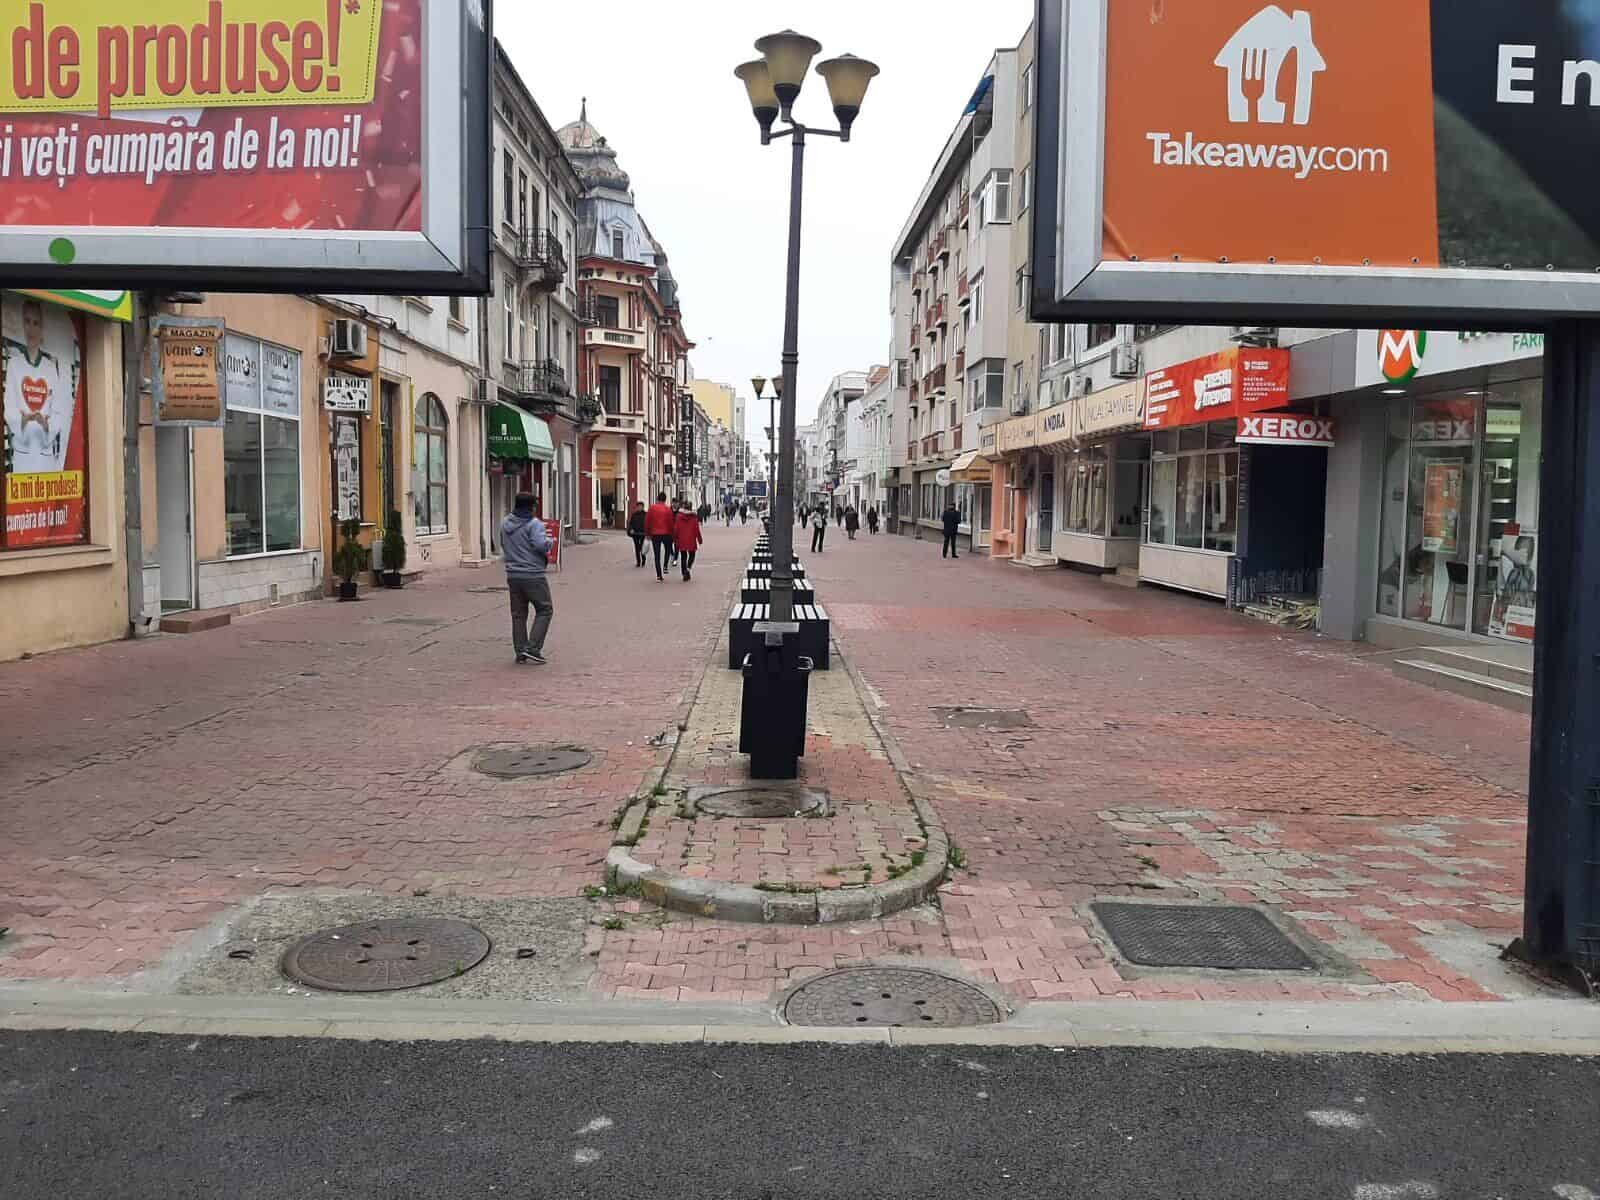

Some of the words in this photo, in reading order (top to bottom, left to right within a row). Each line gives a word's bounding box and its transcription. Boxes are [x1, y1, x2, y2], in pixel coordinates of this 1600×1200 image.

[12, 2, 80, 99] de
[98, 0, 341, 120] produse!
[0, 124, 13, 176] i
[85, 119, 215, 185] cumpăra
[222, 117, 259, 170] de
[267, 116, 295, 169] la
[303, 114, 361, 168] noi!
[1145, 131, 1388, 179] Takeaway.com
[170, 328, 215, 337] MAGAZIN
[327, 377, 343, 388] AIR
[345, 377, 369, 388] SOFT
[1044, 411, 1066, 432] ANDRA
[1240, 417, 1334, 440] XEROX
[35, 475, 45, 498] de
